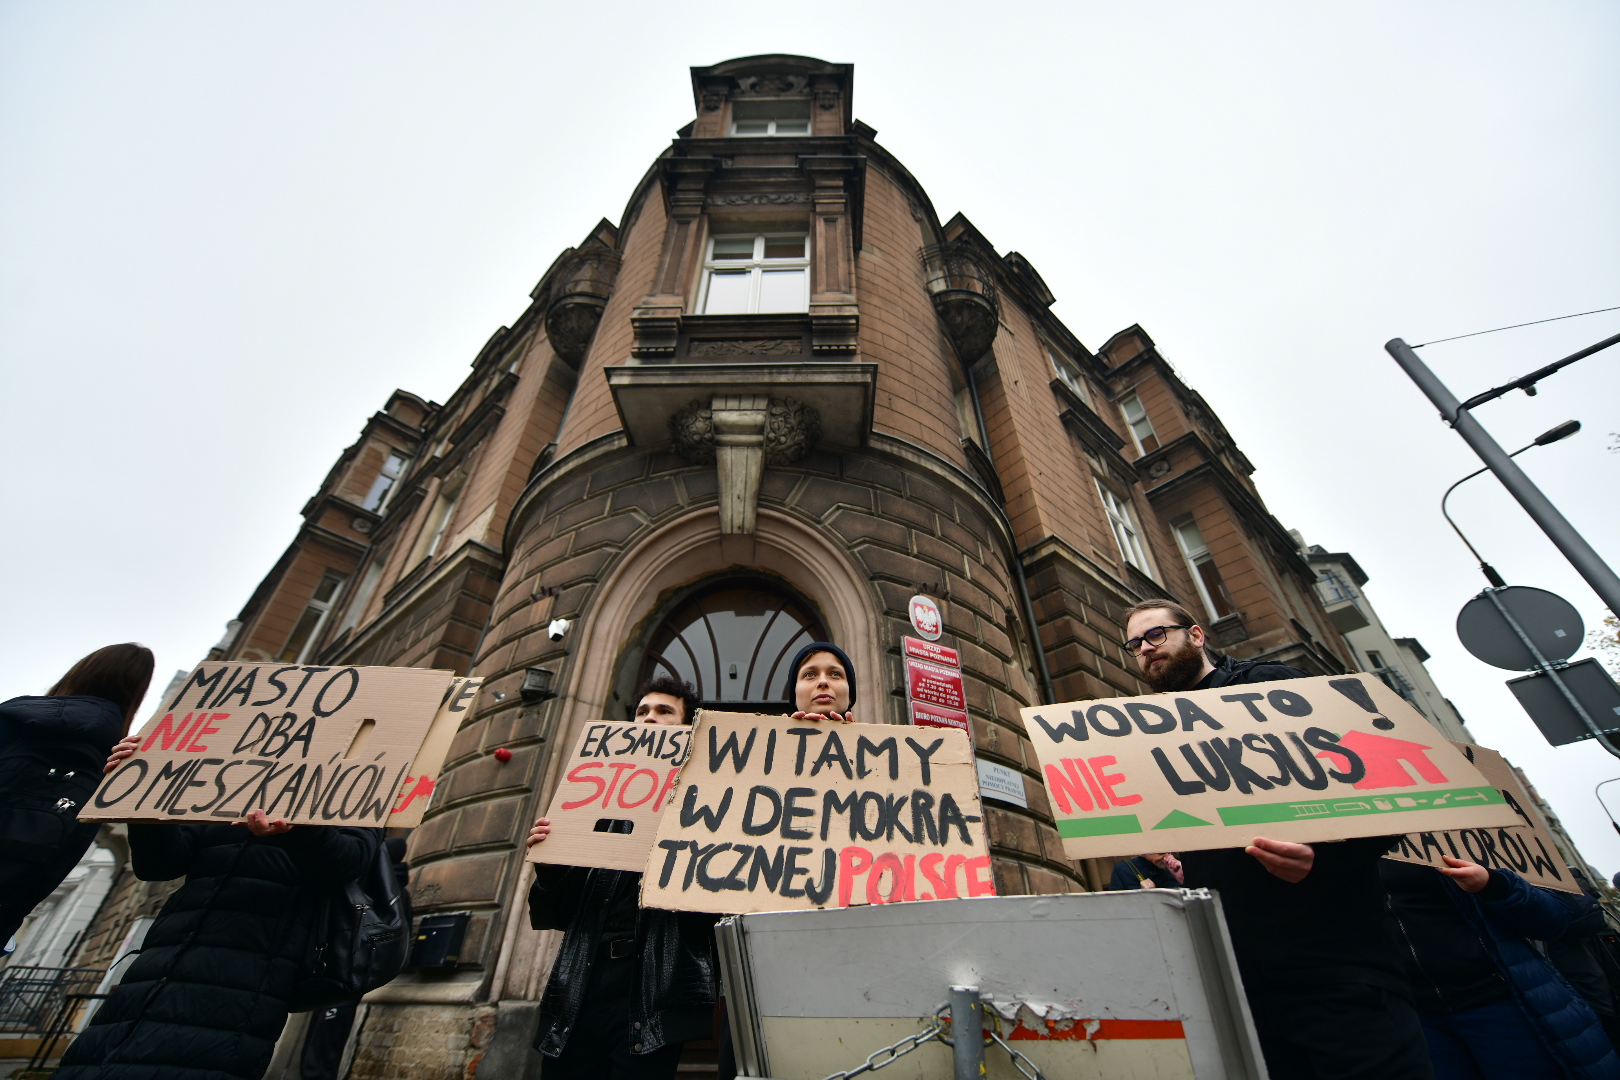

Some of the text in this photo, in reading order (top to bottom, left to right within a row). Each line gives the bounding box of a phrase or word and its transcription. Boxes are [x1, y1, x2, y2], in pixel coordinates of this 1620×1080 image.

[910, 646, 956, 664] MIASTA POZNANIA
[924, 664, 939, 674] MIASTA
[168, 665, 359, 717] MIASTO
[915, 711, 930, 721] BIURO
[1033, 697, 1222, 743] WODA
[1221, 689, 1314, 723] TO
[140, 711, 316, 759] NIE DBA
[579, 724, 693, 767] EKSMISJ
[708, 725, 944, 786] WITAMY
[94, 758, 149, 809] O
[134, 751, 409, 822] MIESZKAŃCÓW
[1044, 726, 1366, 815] NIE LUKSUS
[679, 784, 981, 846] W DEMOKRA-
[657, 839, 837, 905] TYCZNEJ
